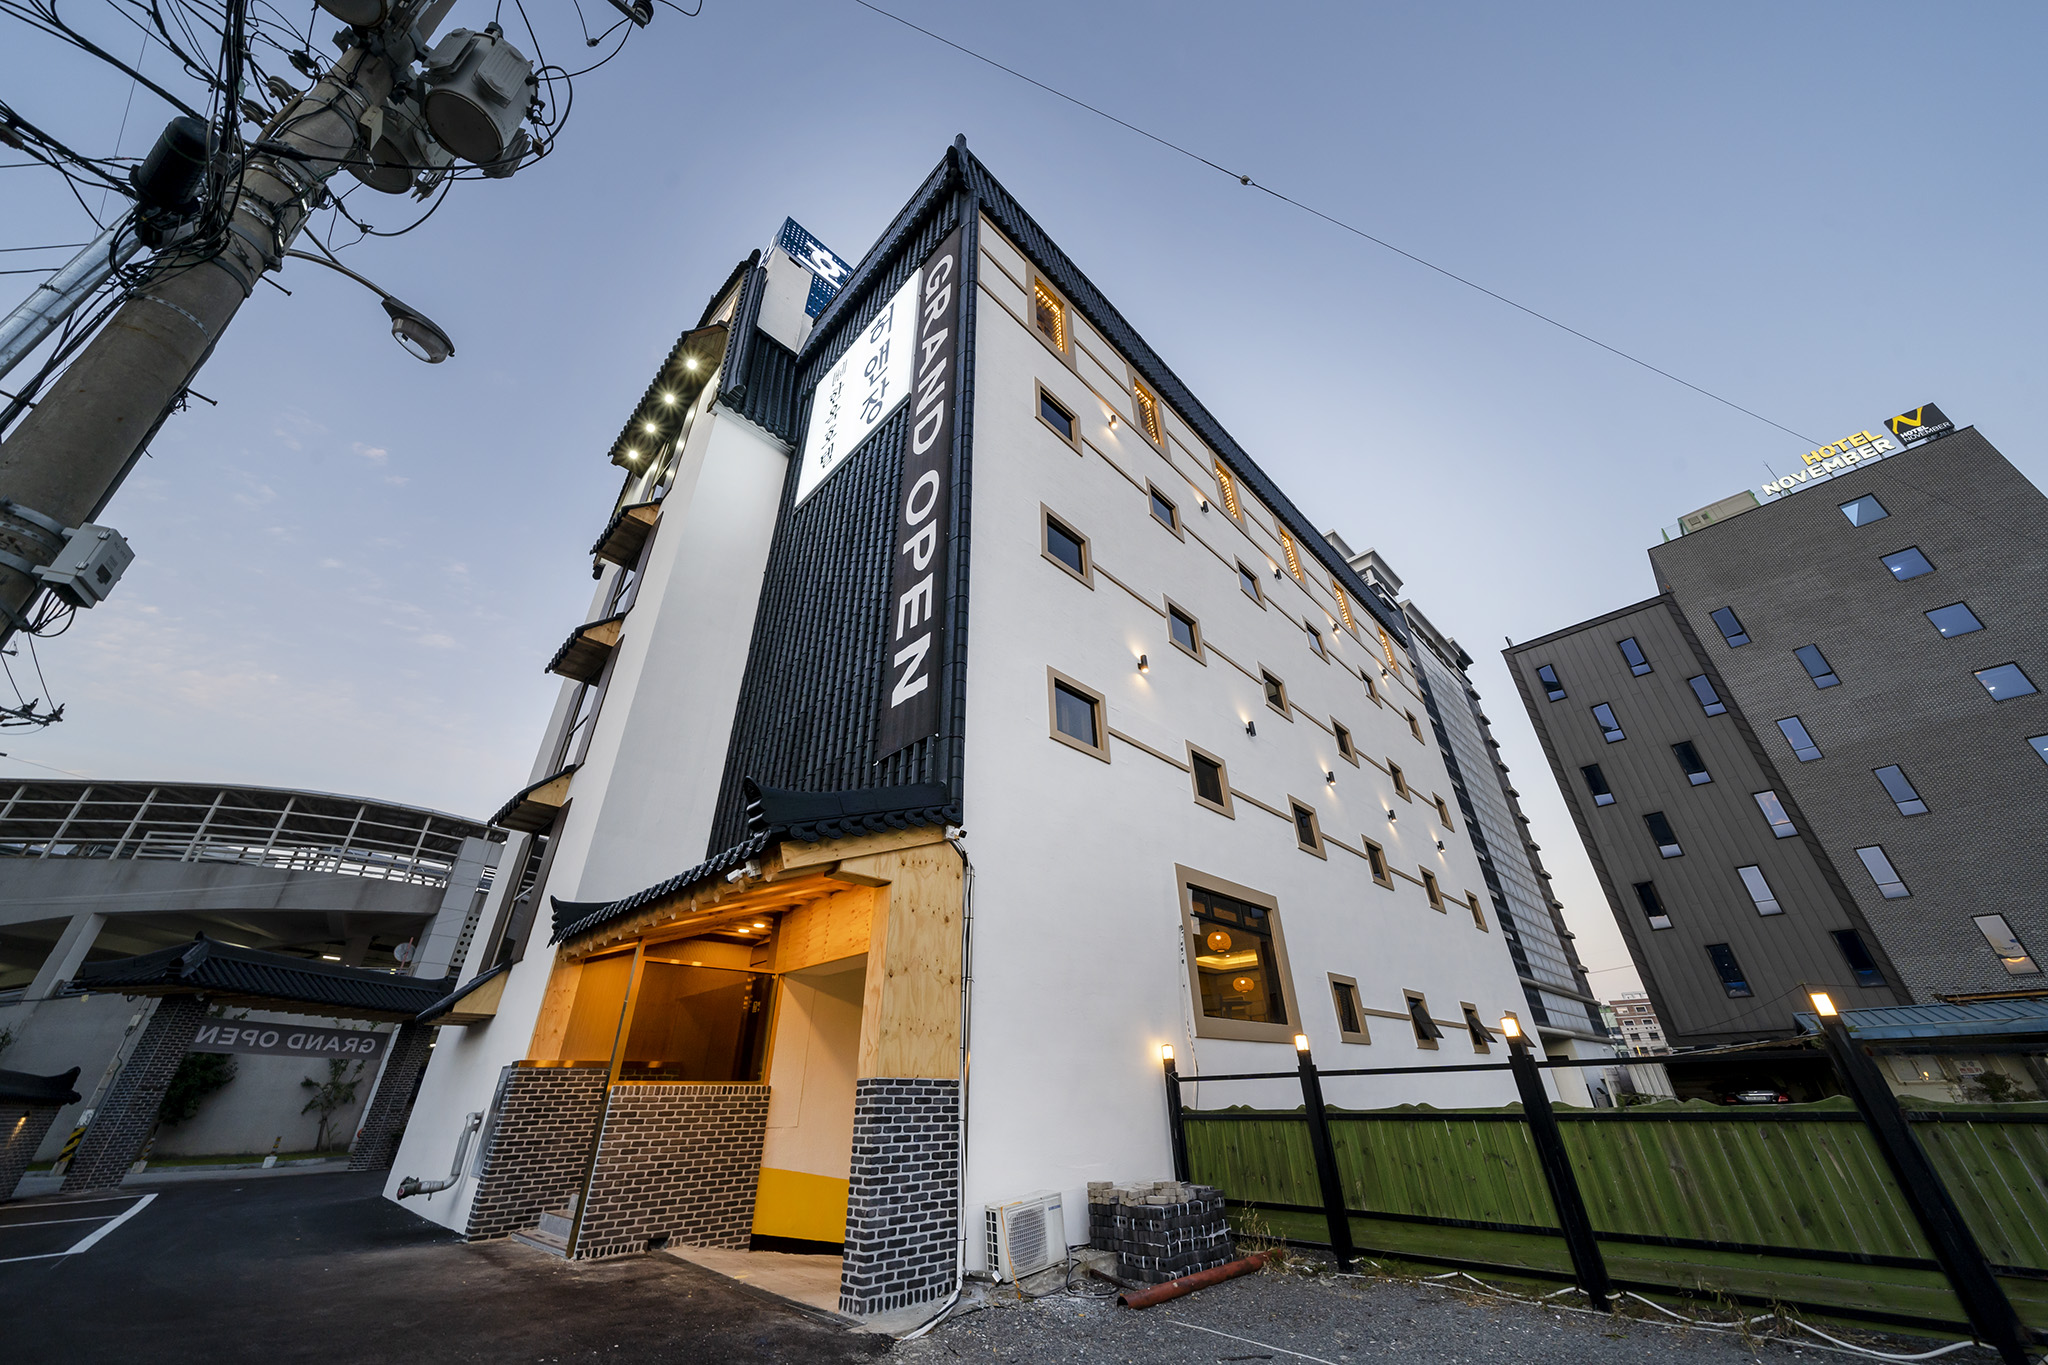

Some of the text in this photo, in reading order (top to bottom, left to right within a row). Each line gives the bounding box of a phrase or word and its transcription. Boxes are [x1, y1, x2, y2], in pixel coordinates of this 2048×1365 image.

[860, 302, 895, 425] 허앤장
[1801, 430, 1883, 466] HOTEL
[1900, 425, 1930, 438] HOTEL
[1903, 421, 1951, 442] NOVEMBER
[891, 254, 954, 708] GRAND OPEN
[1761, 438, 1896, 496] NOVEMBER
